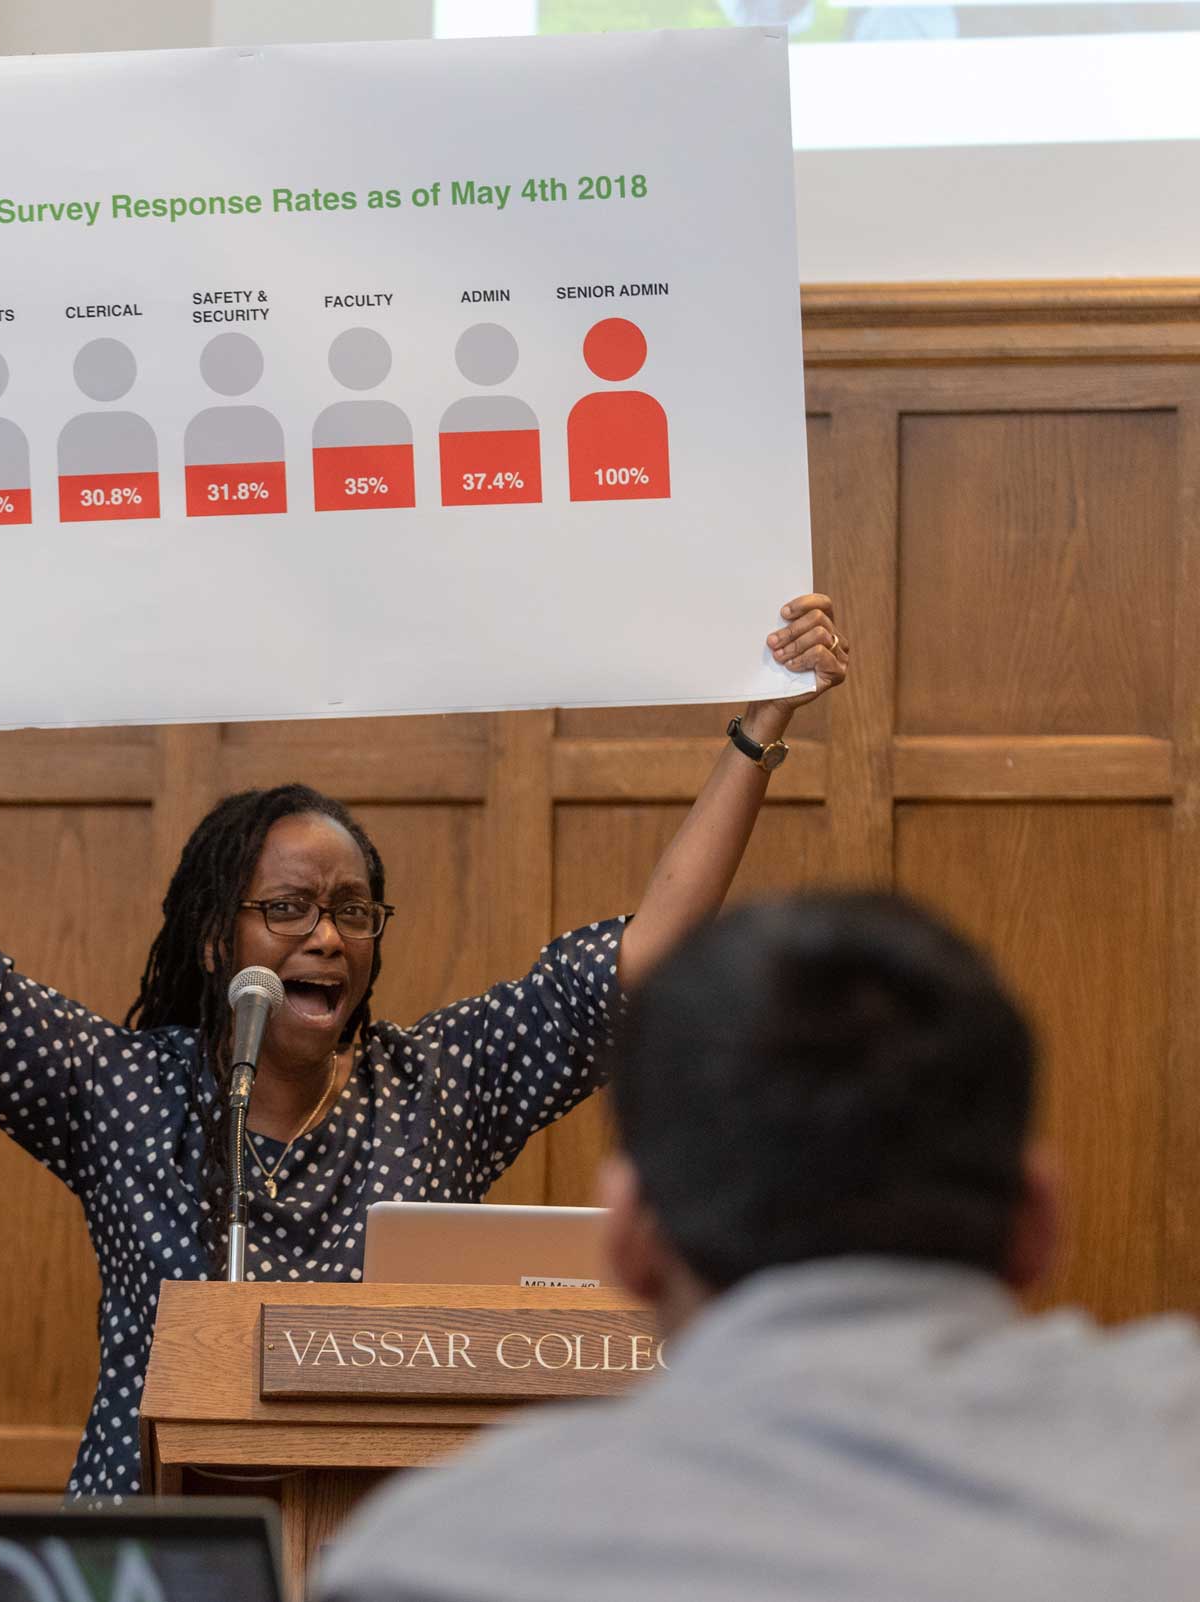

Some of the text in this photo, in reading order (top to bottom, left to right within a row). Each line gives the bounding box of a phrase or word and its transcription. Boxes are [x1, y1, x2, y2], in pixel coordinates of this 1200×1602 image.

[112, 194, 262, 223] Response
[271, 188, 357, 213] Rates
[367, 190, 401, 209] as
[411, 182, 441, 208] of
[451, 180, 511, 209] May
[519, 177, 568, 202] 4th
[578, 175, 648, 201] 2018
[192, 290, 268, 305] SAFETY &
[324, 293, 393, 308] FACULTY
[460, 289, 511, 303] ADMIN
[556, 283, 669, 301] SENIOR ADMIN
[65, 303, 142, 319] CLERICAL
[192, 308, 270, 324] SECURITY
[462, 471, 524, 491] 37.4%
[594, 467, 650, 485] 100%
[207, 482, 269, 501] 31.8%
[345, 477, 389, 495] 35%
[80, 487, 142, 507] 30.8%
[283, 1330, 476, 1368] VASSAR
